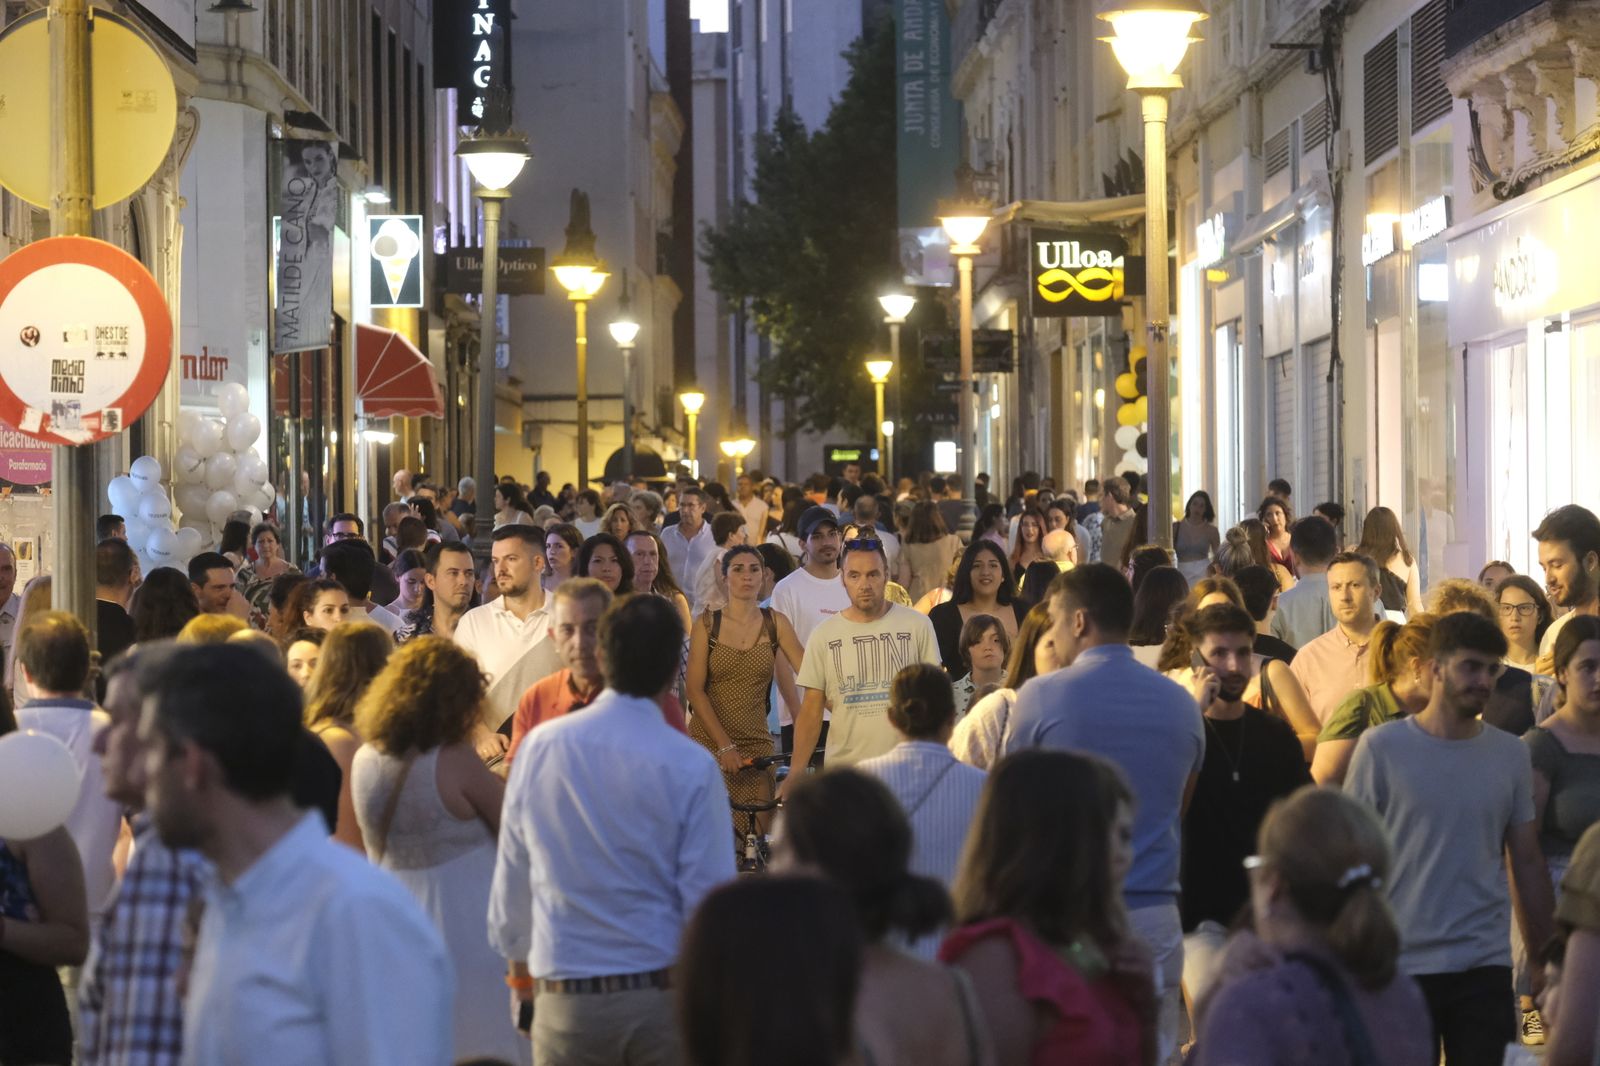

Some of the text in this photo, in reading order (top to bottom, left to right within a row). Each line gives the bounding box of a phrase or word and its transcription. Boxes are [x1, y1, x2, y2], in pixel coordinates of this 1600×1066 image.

[903, 51, 924, 73] DE
[903, 80, 925, 136] JUNTA
[282, 177, 306, 340] MATILDE CANO
[1036, 241, 1113, 269] Ulloa
[50, 376, 84, 393] ninho
[828, 632, 911, 694] LDN
